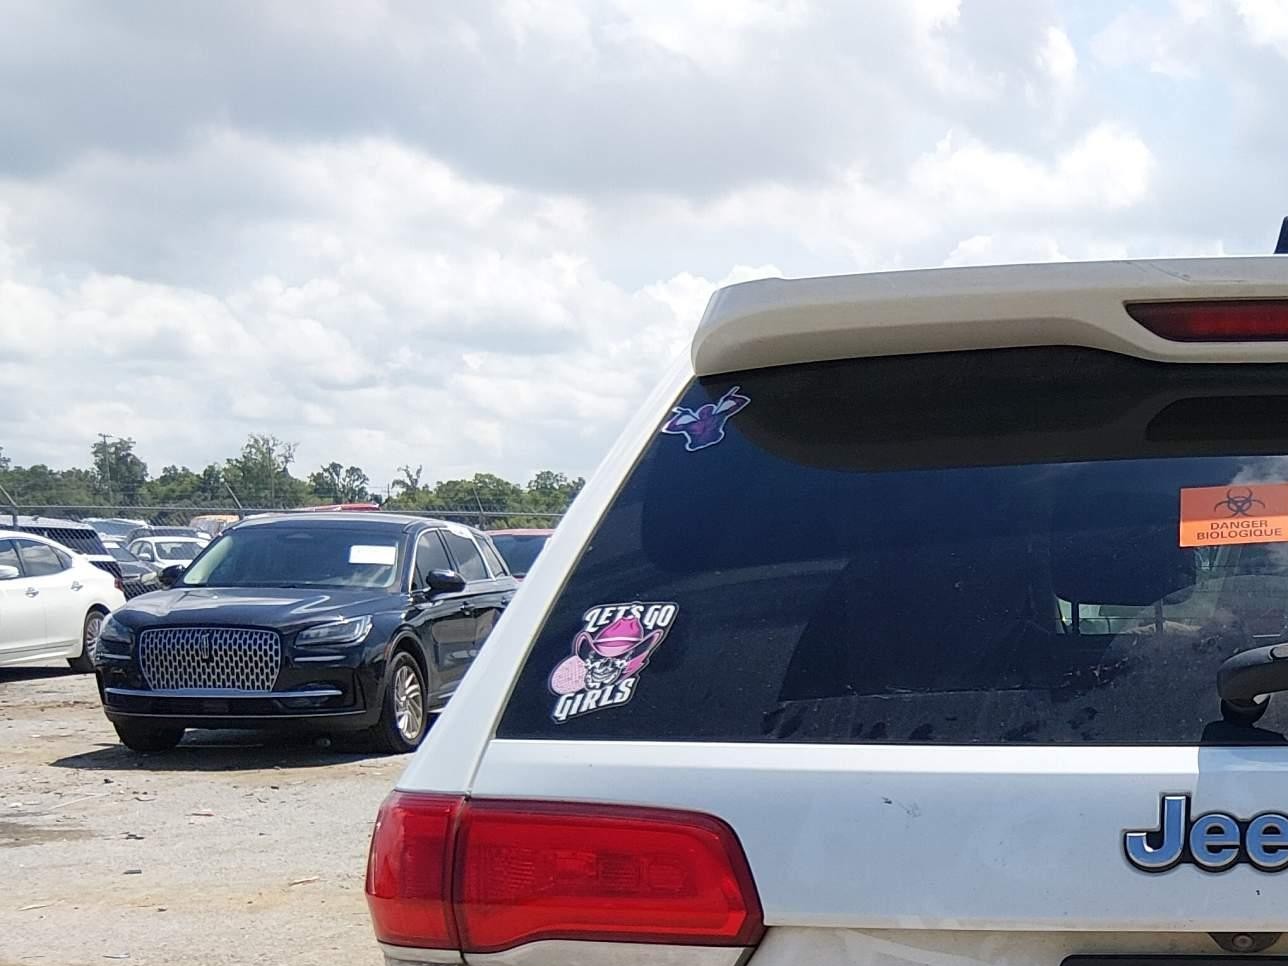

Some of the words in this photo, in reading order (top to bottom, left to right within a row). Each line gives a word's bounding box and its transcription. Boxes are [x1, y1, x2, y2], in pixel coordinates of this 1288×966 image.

[1196, 527, 1282, 541] BIOLOGIQUE
[1210, 519, 1268, 531] DANGER
[644, 604, 676, 630] GO
[553, 677, 636, 721] GIRLS
